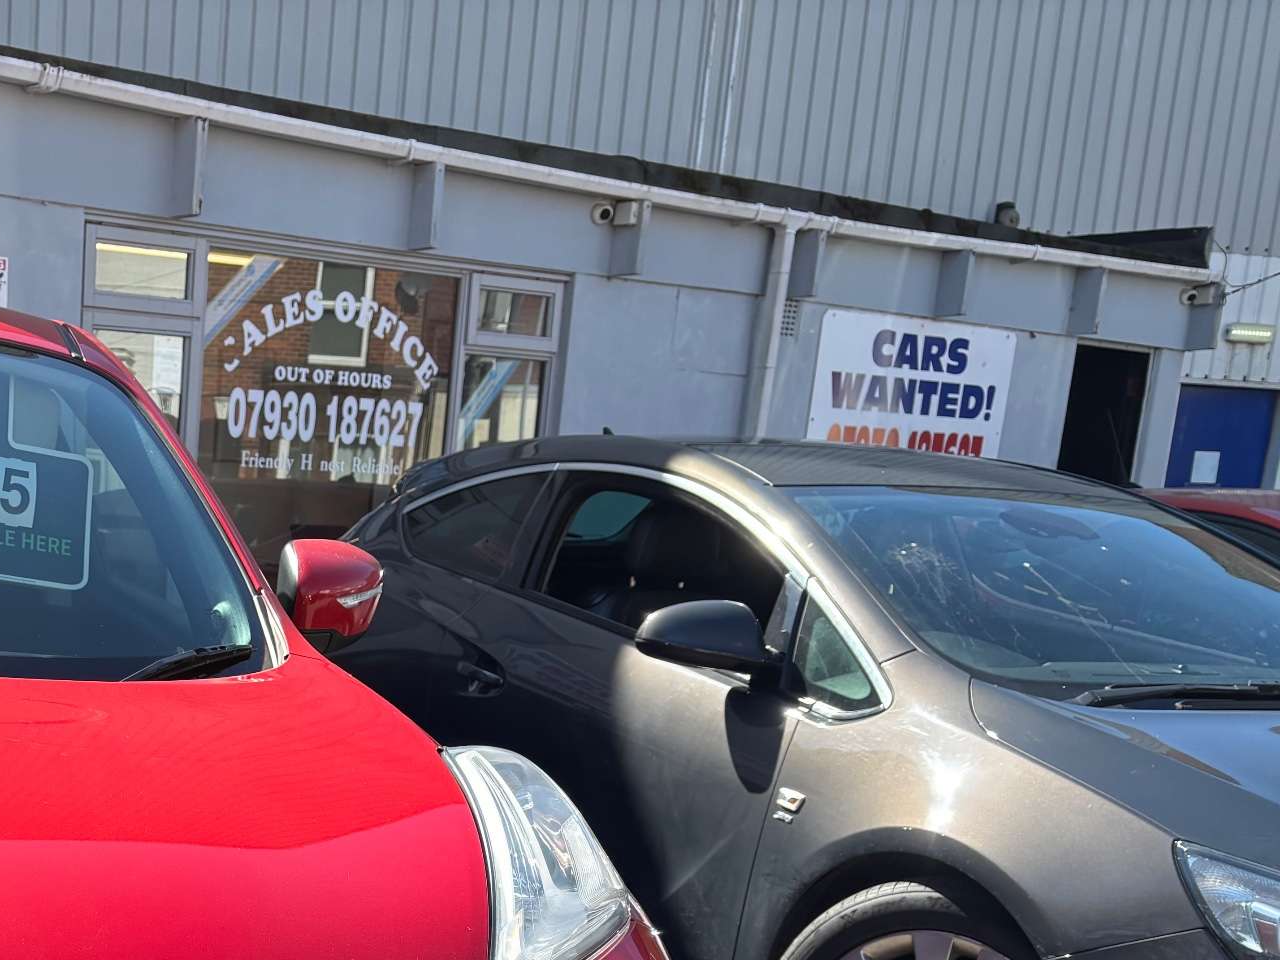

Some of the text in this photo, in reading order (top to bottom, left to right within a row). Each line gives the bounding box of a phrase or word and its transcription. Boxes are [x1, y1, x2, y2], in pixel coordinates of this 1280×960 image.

[335, 291, 439, 390] OFFICE
[872, 329, 970, 375] CARS
[275, 366, 392, 389] OUT OF HOURS
[832, 371, 996, 422] WANTED!
[228, 387, 423, 448] 07930 187627
[22, 531, 72, 557] HERE
